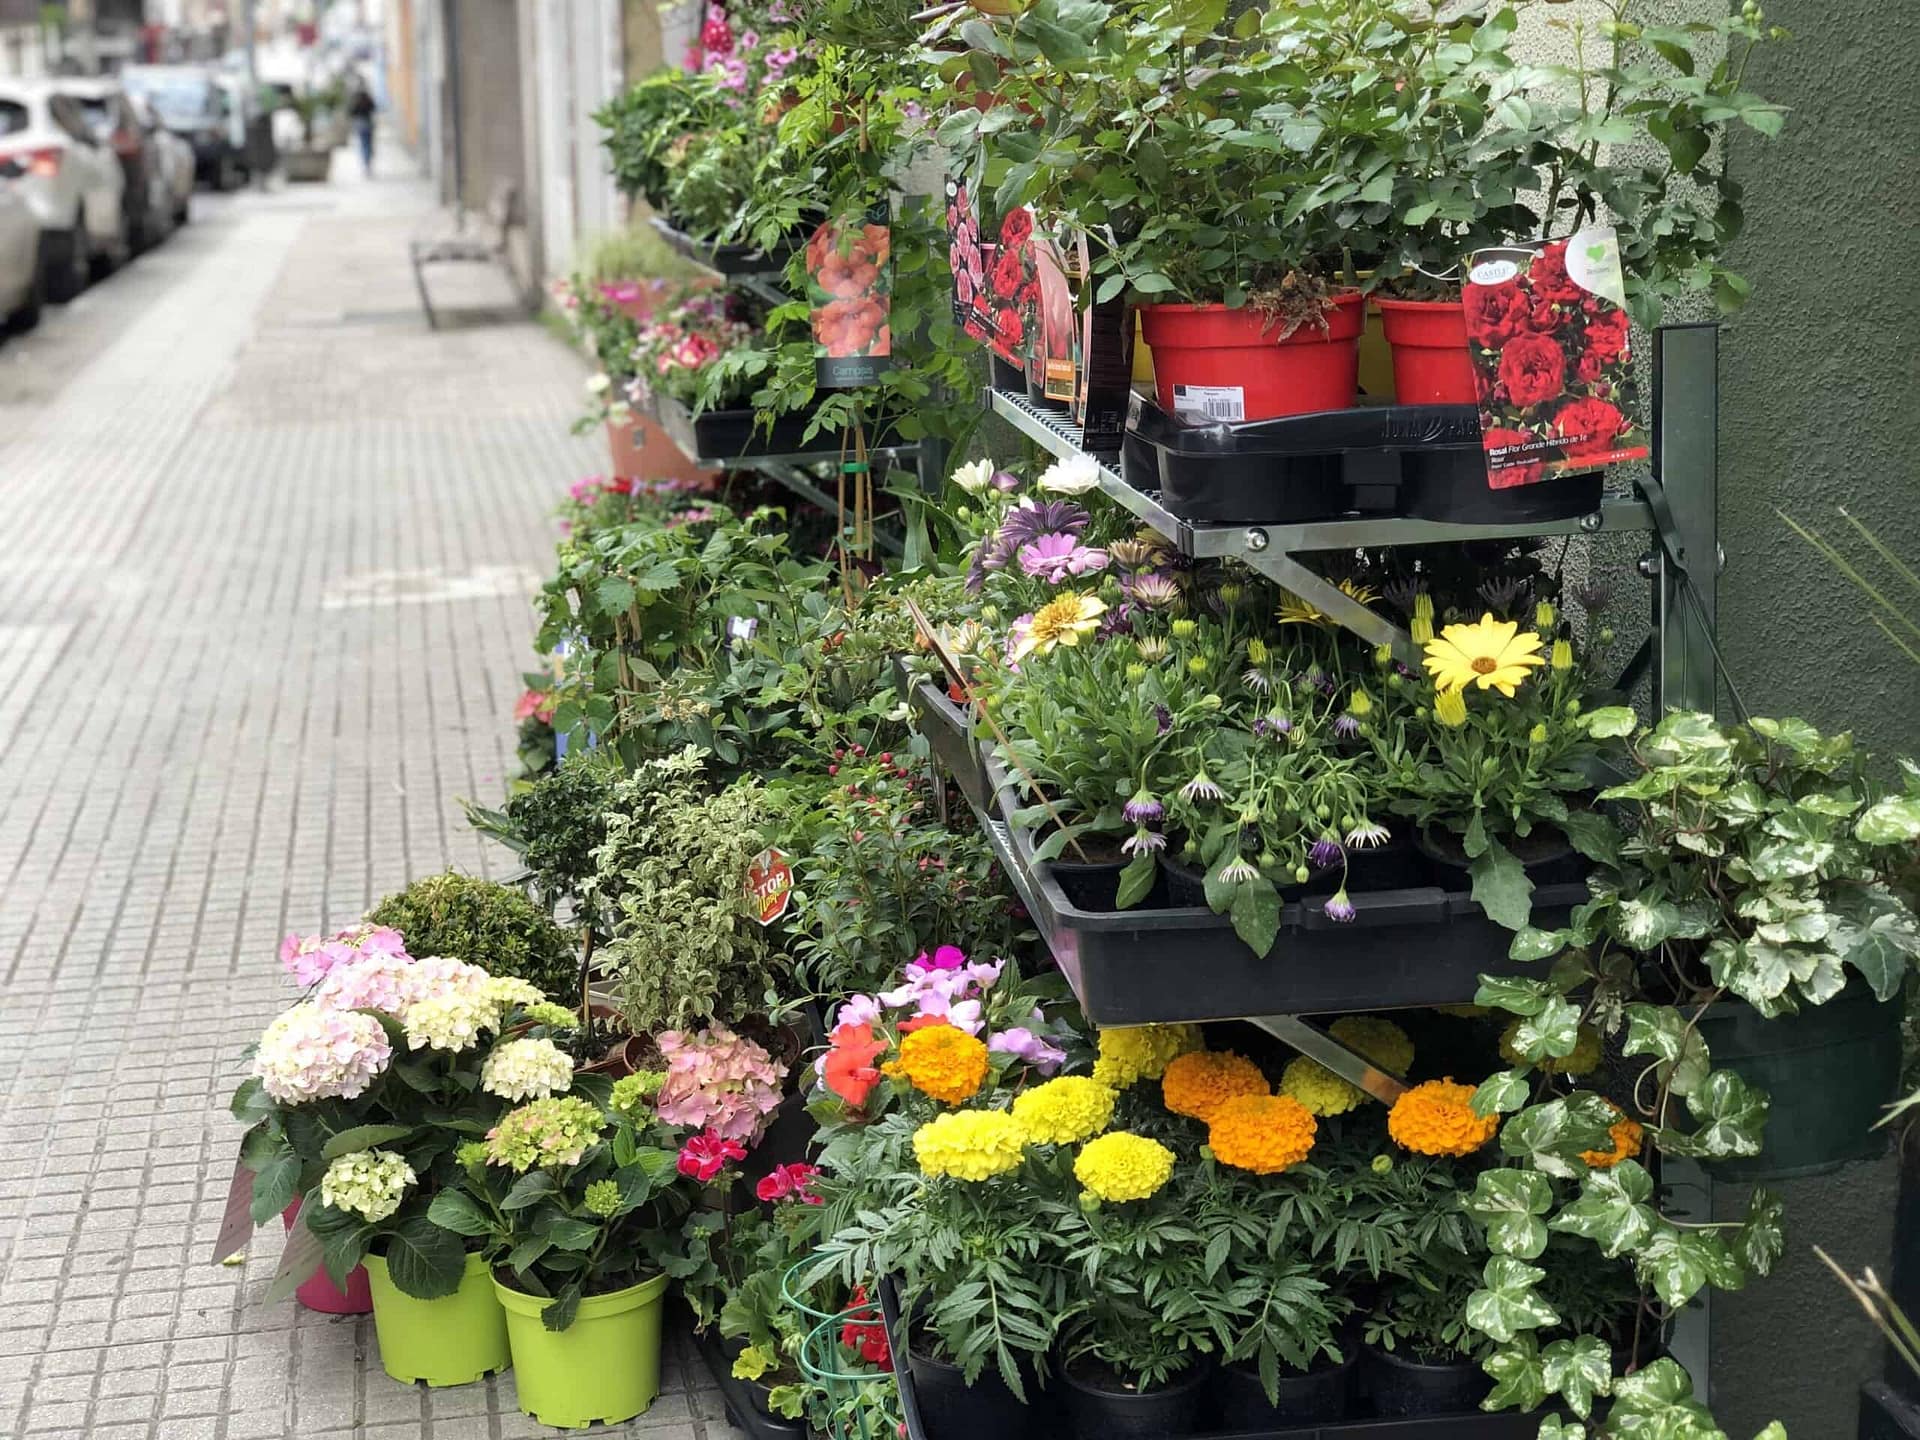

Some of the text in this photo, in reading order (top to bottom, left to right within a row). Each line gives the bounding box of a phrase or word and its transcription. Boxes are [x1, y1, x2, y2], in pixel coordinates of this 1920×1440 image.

[1489, 446, 1508, 456] Rosal
[1508, 445, 1520, 454] Flor
[1521, 441, 1546, 451] Grande
[1569, 435, 1578, 443] de
